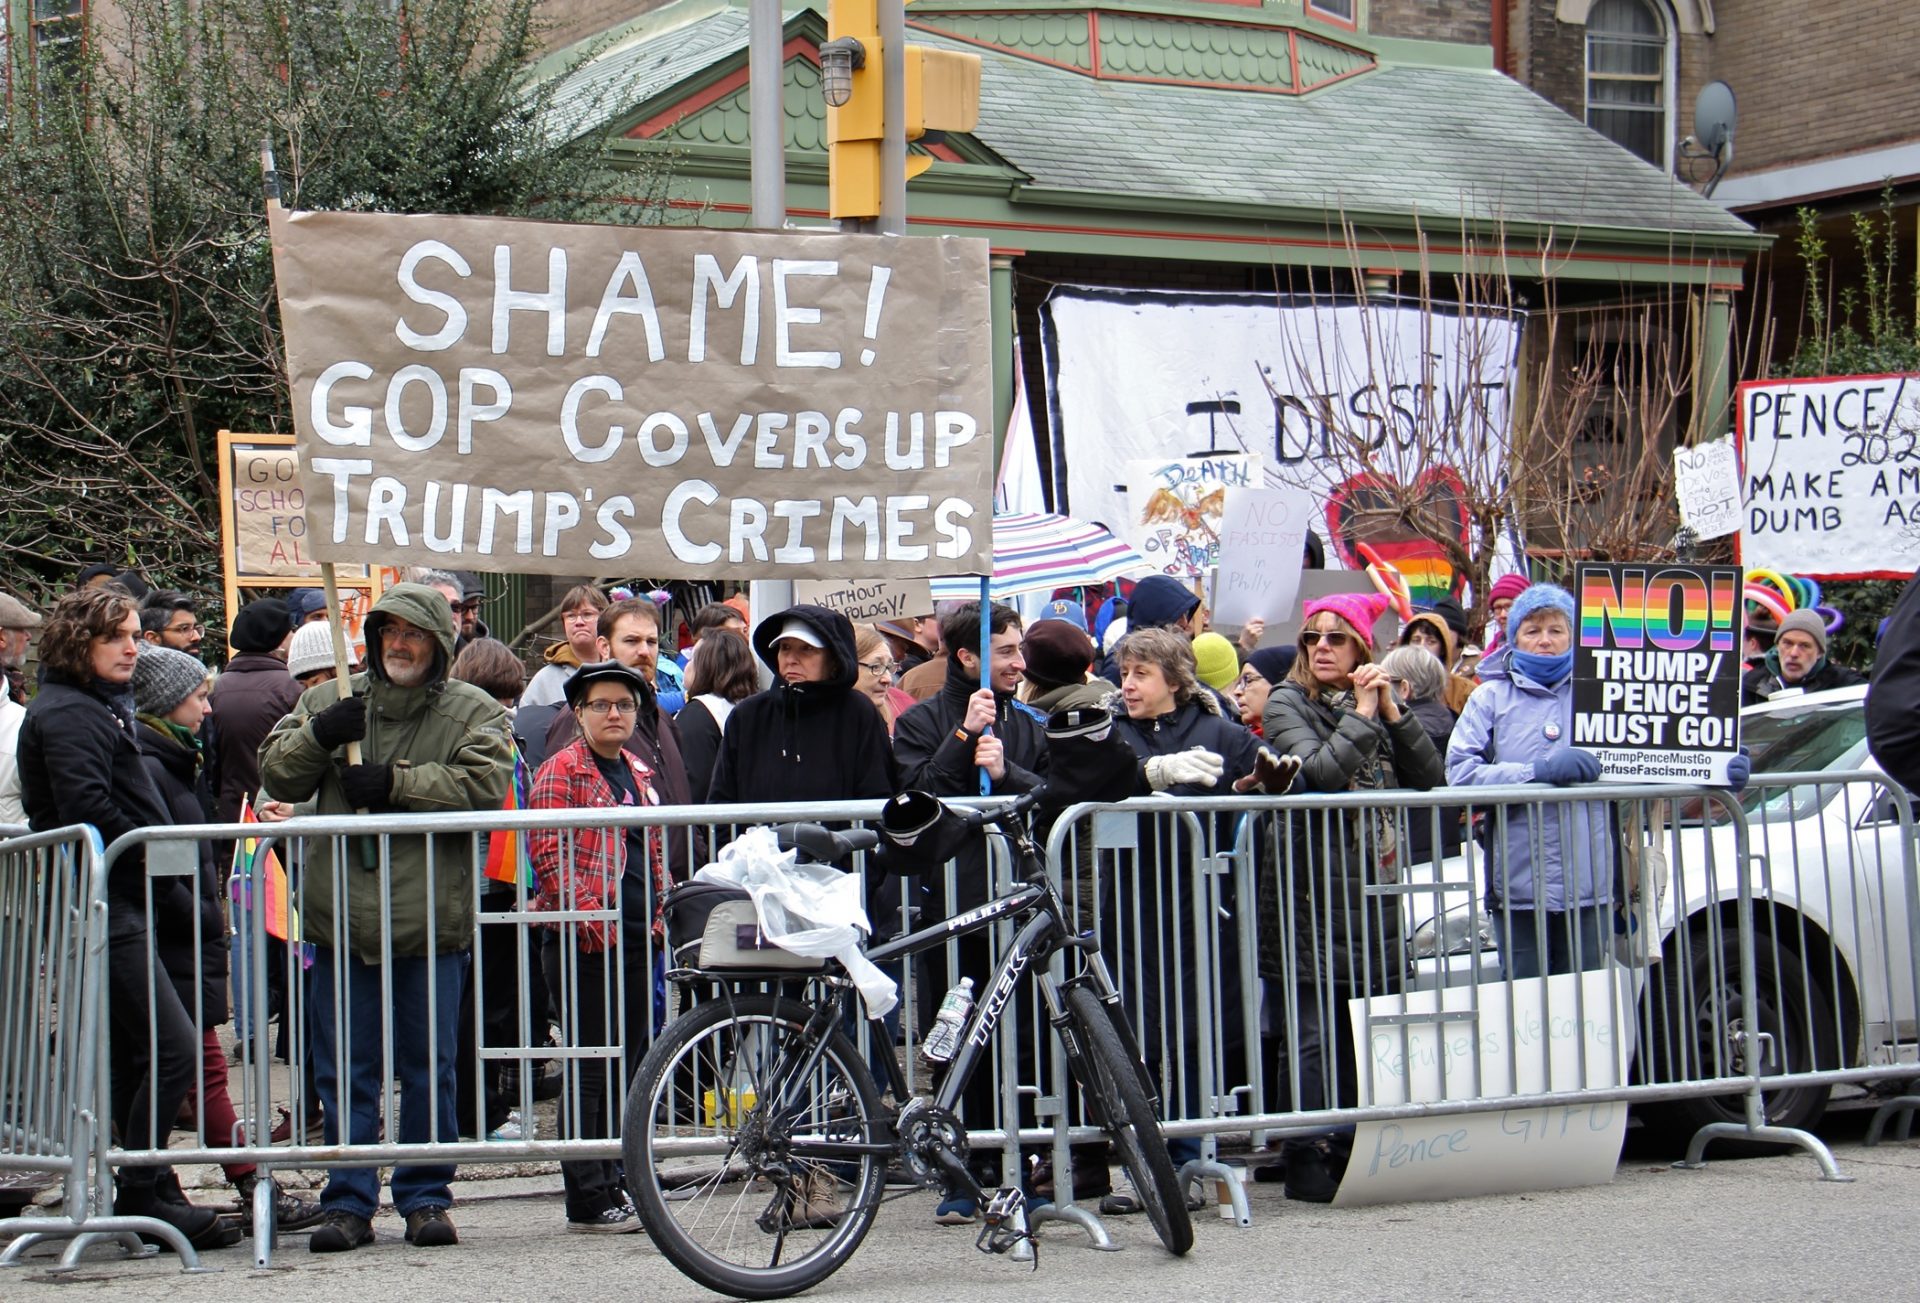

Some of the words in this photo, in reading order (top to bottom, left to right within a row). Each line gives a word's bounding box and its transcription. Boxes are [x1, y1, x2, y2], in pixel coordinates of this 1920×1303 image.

[395, 239, 891, 369] SHAME!
[311, 361, 513, 454] GOP
[560, 375, 867, 471] COVERS
[884, 411, 976, 470] UP
[1185, 400, 1241, 459] I
[1273, 381, 1503, 464] DISSENT
[248, 457, 294, 483] GO
[1750, 470, 1844, 501] MAKE
[240, 488, 304, 512] SCHO
[311, 457, 635, 558] TRUMP'S
[661, 479, 976, 564] CRIMES
[1244, 501, 1289, 527] NO
[1688, 496, 1735, 519] NOT
[272, 516, 305, 537] FO
[1751, 506, 1842, 535] DUMB
[270, 540, 322, 565] AL
[814, 583, 887, 608] WITHOUT
[834, 593, 906, 618] POLOGY!
[1580, 568, 1736, 651] NO!
[1591, 650, 1723, 683] TRUMP/
[1602, 682, 1709, 714] PENCE
[1574, 713, 1668, 745] MUST
[1677, 716, 1734, 747] GO!
[1596, 750, 1712, 765] #TrumpPenceMustGo
[948, 900, 1006, 931] POLICE
[968, 944, 1028, 1046] TREK
[1368, 1125, 1470, 1177] Pence
